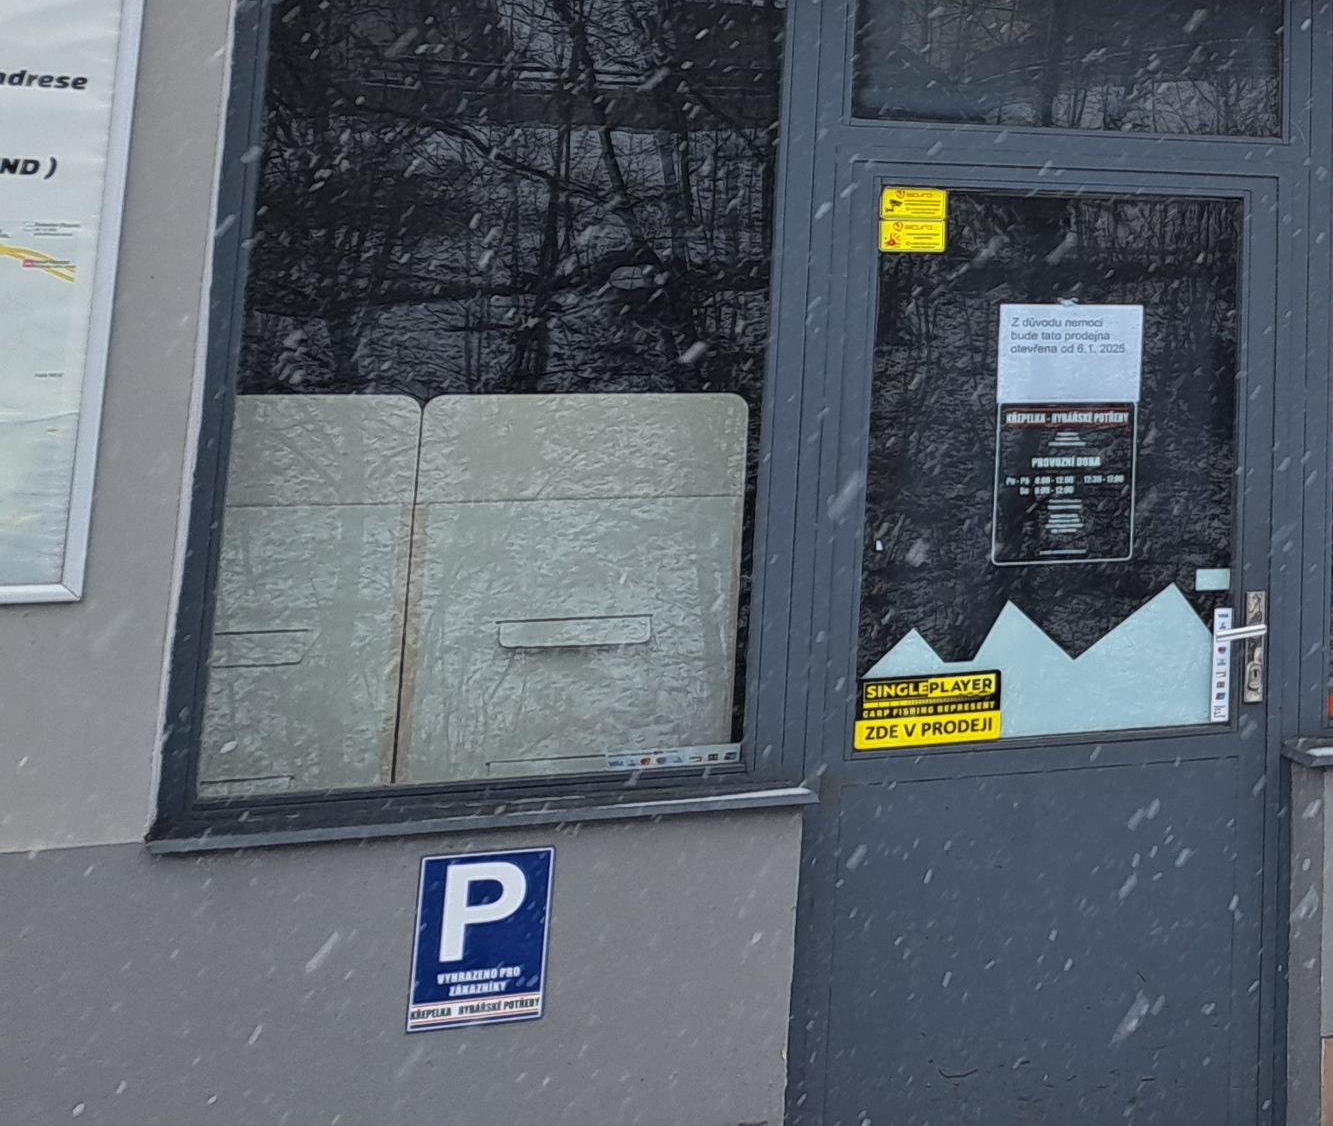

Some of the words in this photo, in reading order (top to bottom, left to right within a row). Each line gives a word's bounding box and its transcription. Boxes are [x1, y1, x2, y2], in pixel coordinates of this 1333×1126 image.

[1011, 317, 1020, 328] Z
[1022, 317, 1062, 328] důvodu
[1010, 331, 1038, 341] bude
[1041, 331, 1062, 341] tato
[1064, 330, 1111, 342] prodejna
[1010, 344, 1057, 354] otevřena
[1060, 343, 1074, 354] od
[1099, 343, 1126, 354] 2025
[863, 708, 890, 718] CARP
[892, 705, 935, 717] FISHING
[865, 724, 899, 740] ZDE
[904, 723, 916, 737] V
[921, 717, 993, 737] PRODEJI
[439, 861, 527, 963] P
[437, 968, 498, 985] VYHRAZENO
[499, 966, 521, 979] PRO
[448, 980, 507, 997] ZÁKAZNÍKY
[410, 1005, 452, 1021] KŘEPELKA
[458, 1000, 501, 1016] RYBÁŘSKÉ
[503, 996, 540, 1011] POTŘEBY
